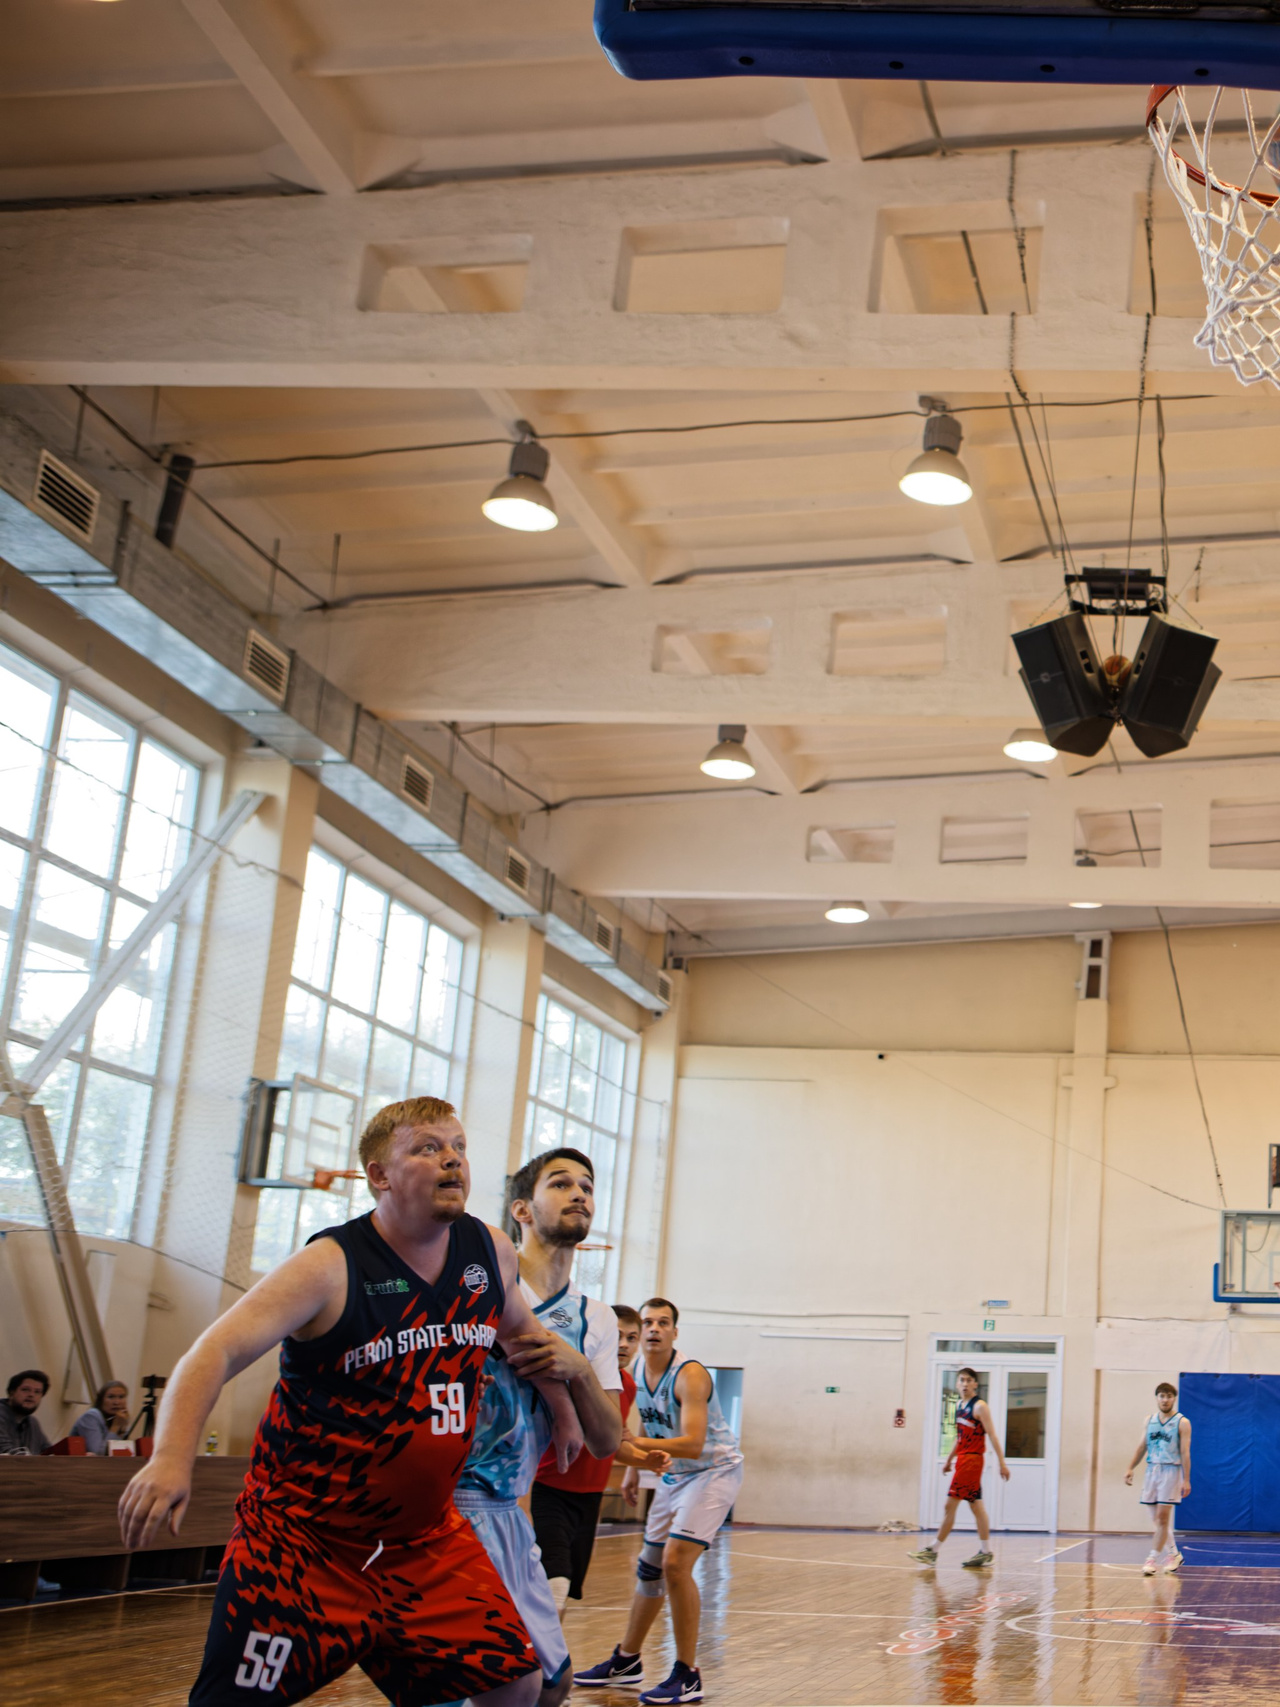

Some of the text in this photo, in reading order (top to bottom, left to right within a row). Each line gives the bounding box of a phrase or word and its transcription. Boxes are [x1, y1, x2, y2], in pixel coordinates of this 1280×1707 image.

[344, 1336, 393, 1374] PERM
[397, 1323, 448, 1355] STATE
[428, 1382, 466, 1436] 59
[235, 1630, 293, 1692] 59
